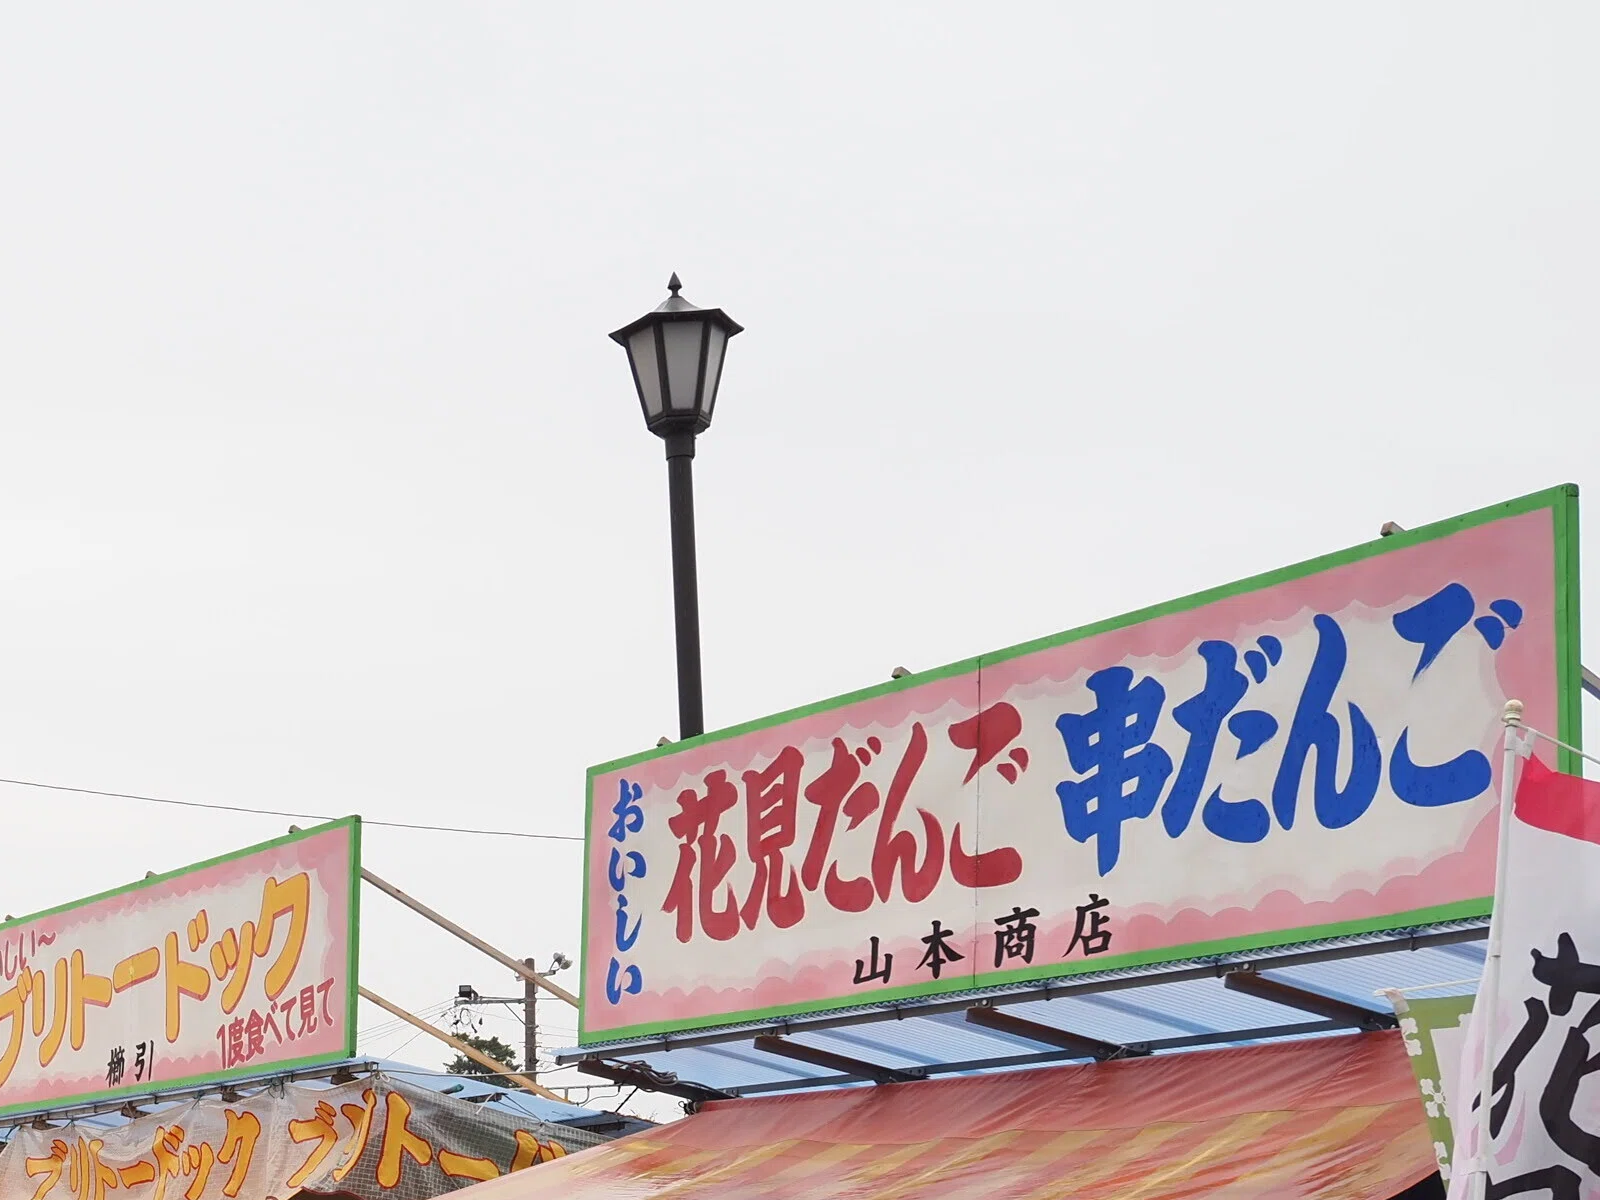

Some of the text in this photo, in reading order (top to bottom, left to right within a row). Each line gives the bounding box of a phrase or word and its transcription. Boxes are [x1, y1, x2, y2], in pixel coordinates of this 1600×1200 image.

[663, 700, 1028, 943] 花見だんご
[1054, 580, 1524, 878] 串だんご
[605, 778, 644, 1006] おいしい
[852, 894, 1113, 986] 山本商店
